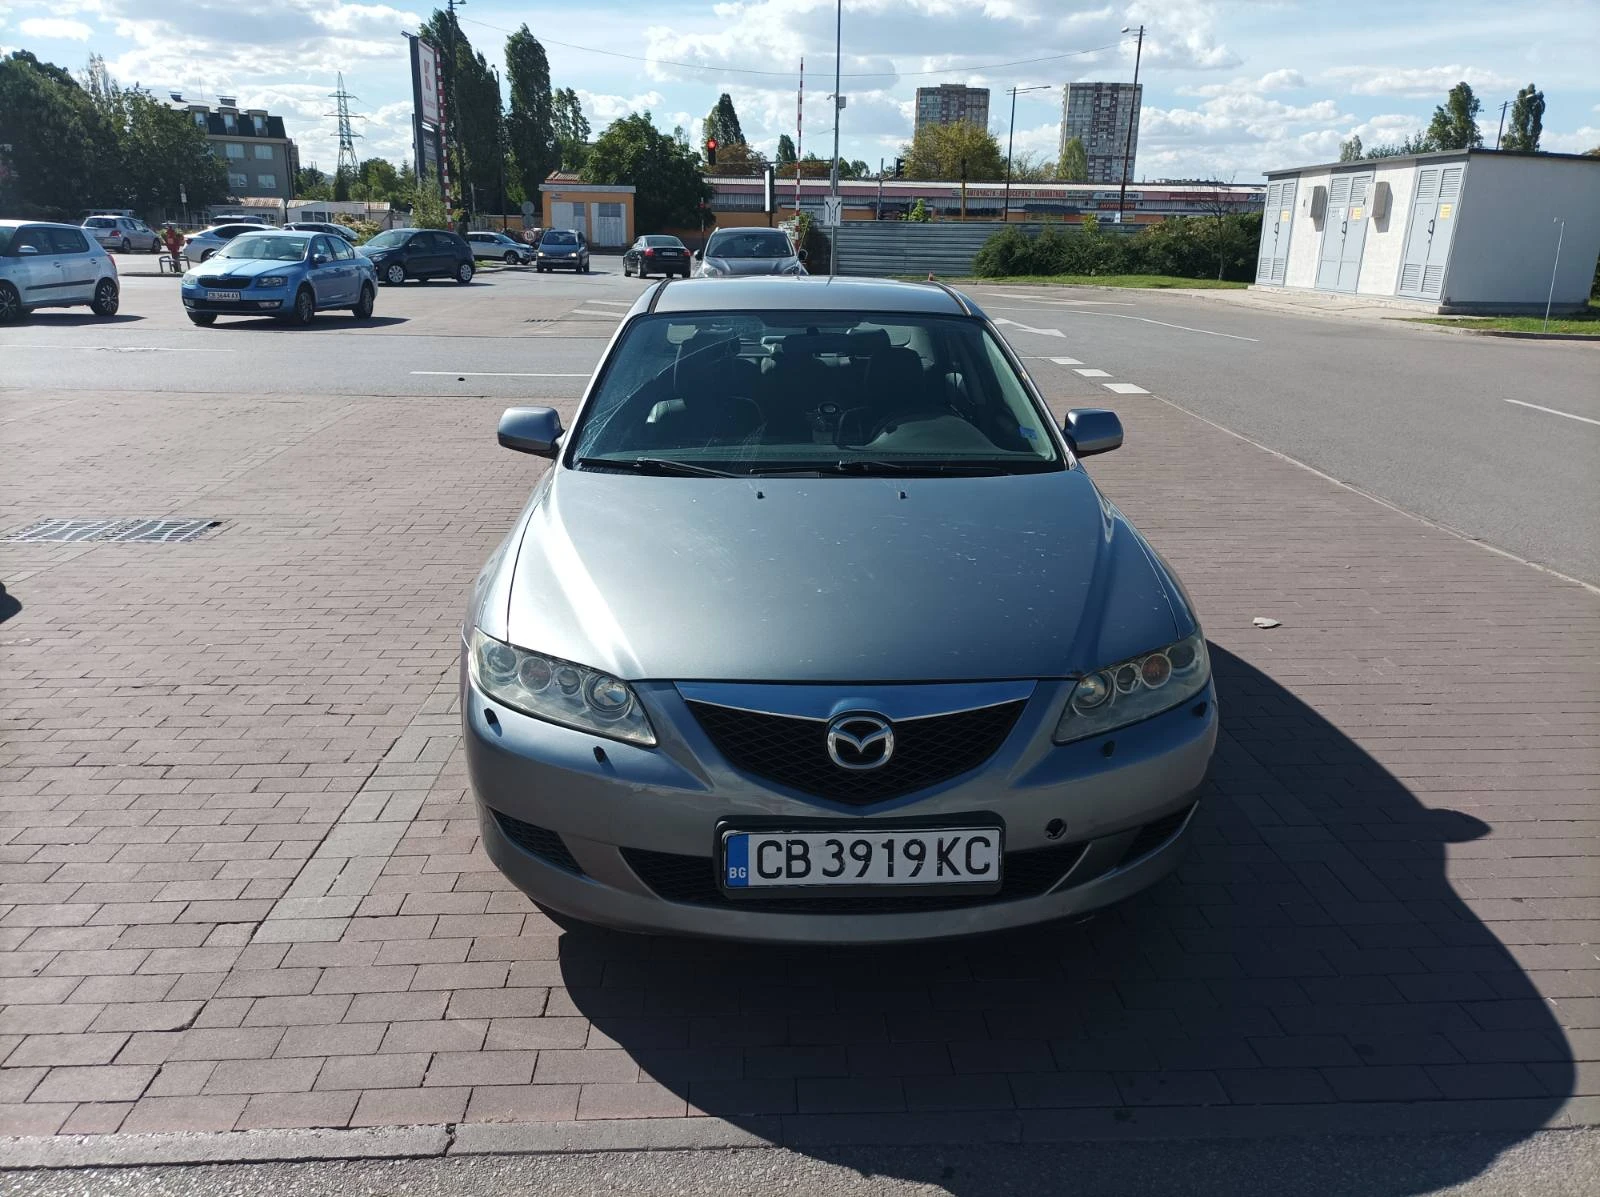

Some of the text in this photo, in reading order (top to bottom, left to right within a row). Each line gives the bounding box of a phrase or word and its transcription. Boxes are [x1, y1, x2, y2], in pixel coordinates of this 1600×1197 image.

[999, 190, 1031, 198] АВОСЕРВИЗ
[756, 836, 991, 879] CB 3919 KC
[728, 867, 747, 879] BG
